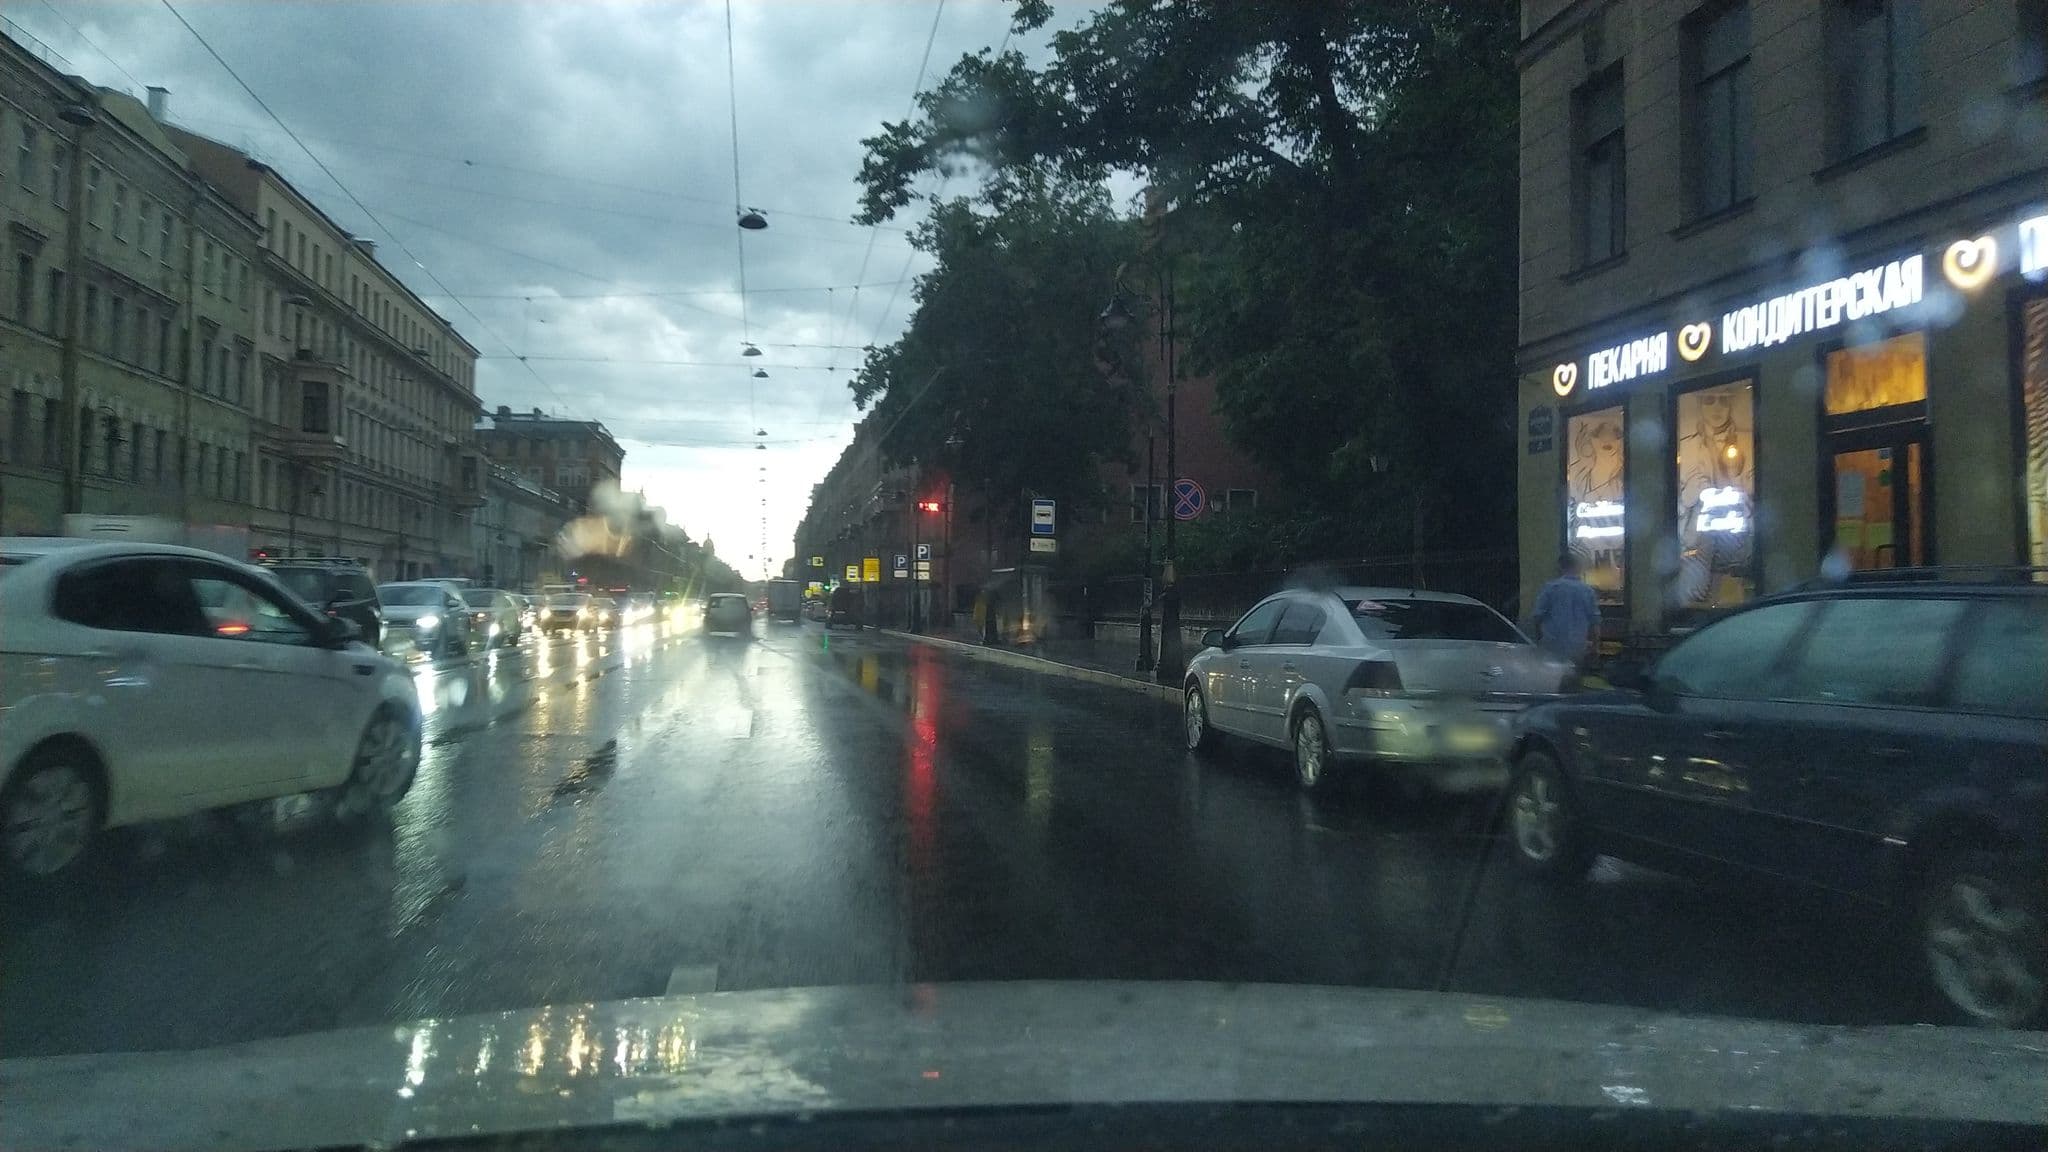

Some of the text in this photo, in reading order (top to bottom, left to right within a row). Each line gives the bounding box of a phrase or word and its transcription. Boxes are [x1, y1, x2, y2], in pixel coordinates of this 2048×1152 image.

[1588, 332, 1667, 390] ПЕКАРНЯ
[1722, 254, 1923, 354] КОНДИТЕРСКАЯ
[918, 546, 927, 558] P
[897, 557, 906, 567] P
